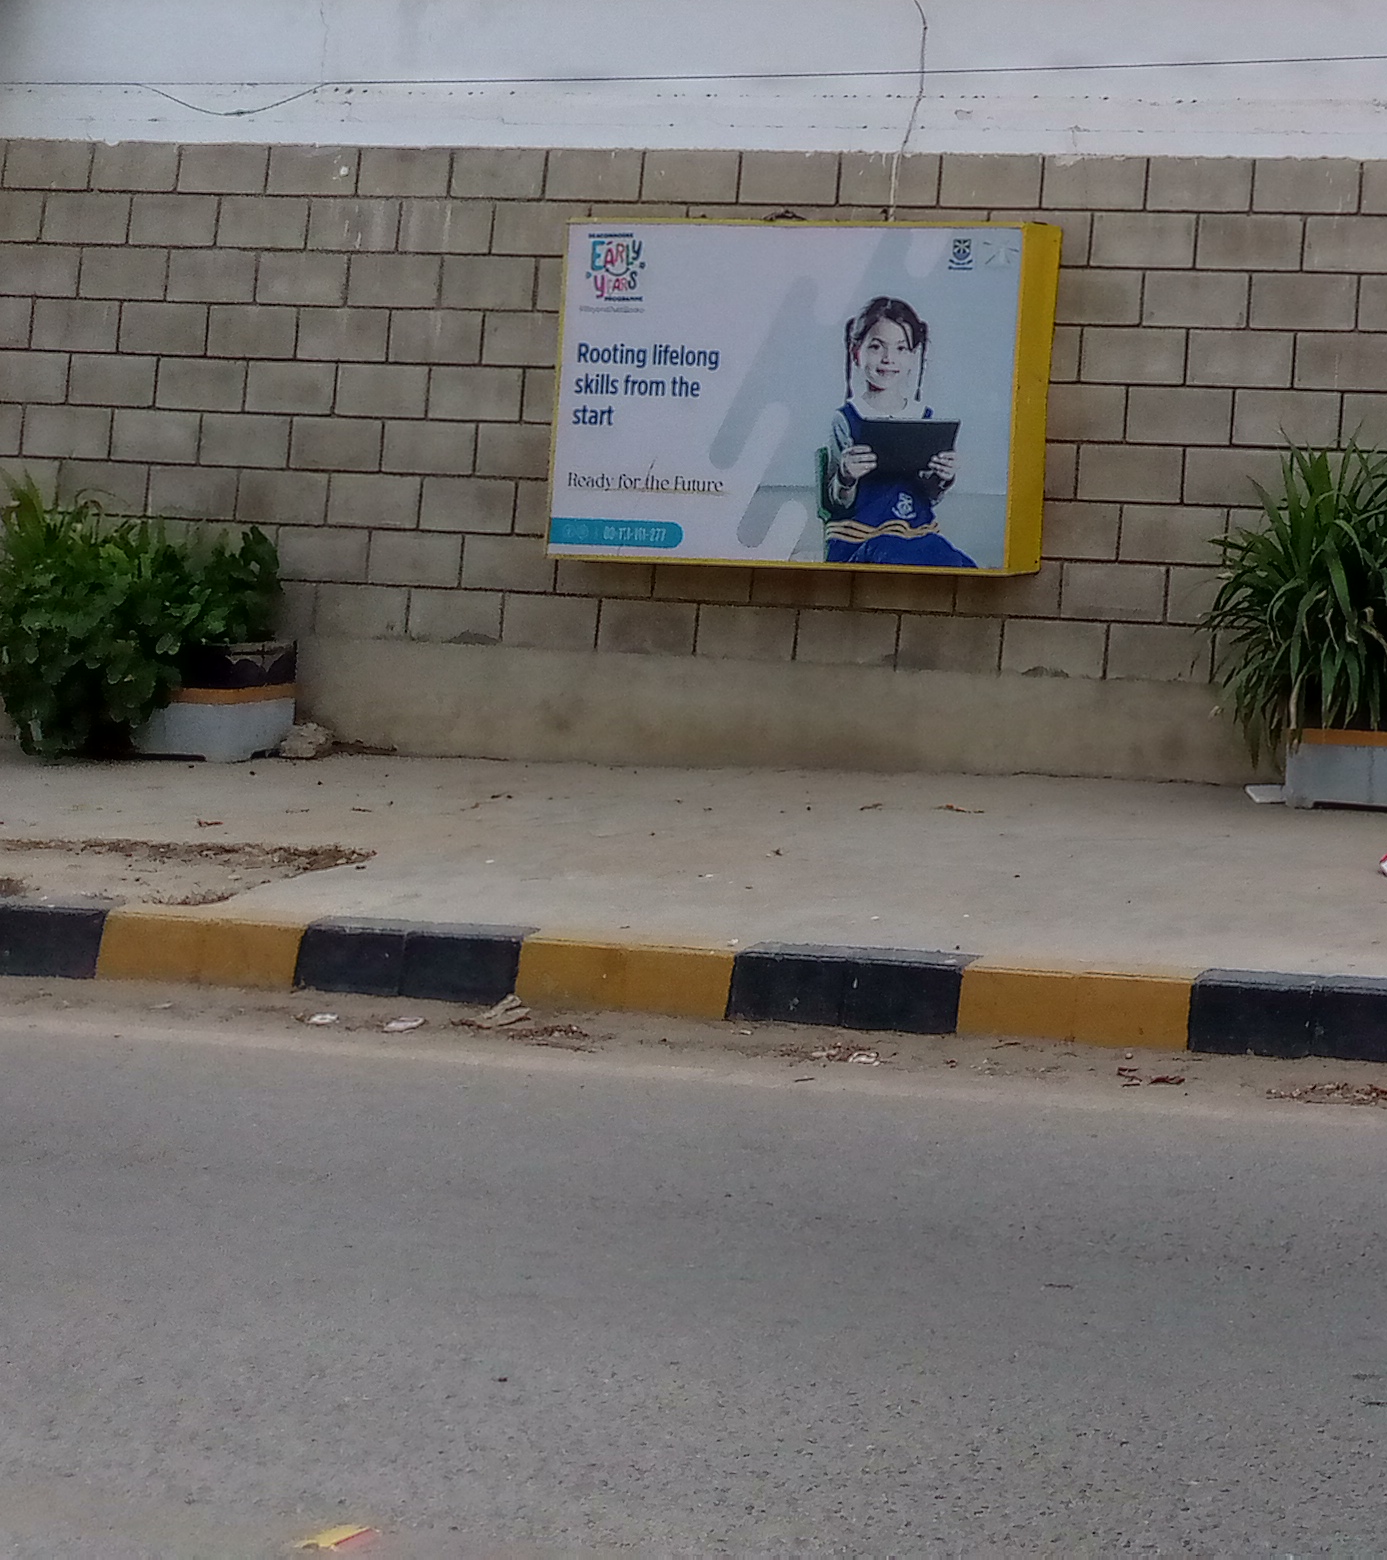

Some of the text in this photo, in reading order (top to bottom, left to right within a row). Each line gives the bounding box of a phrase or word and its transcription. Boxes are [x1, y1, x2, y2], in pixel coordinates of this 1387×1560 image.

[577, 342, 721, 371] Rooting lifelong
[574, 373, 701, 397] skills from the
[572, 405, 614, 426] start
[568, 472, 724, 492] Ready for the Future
